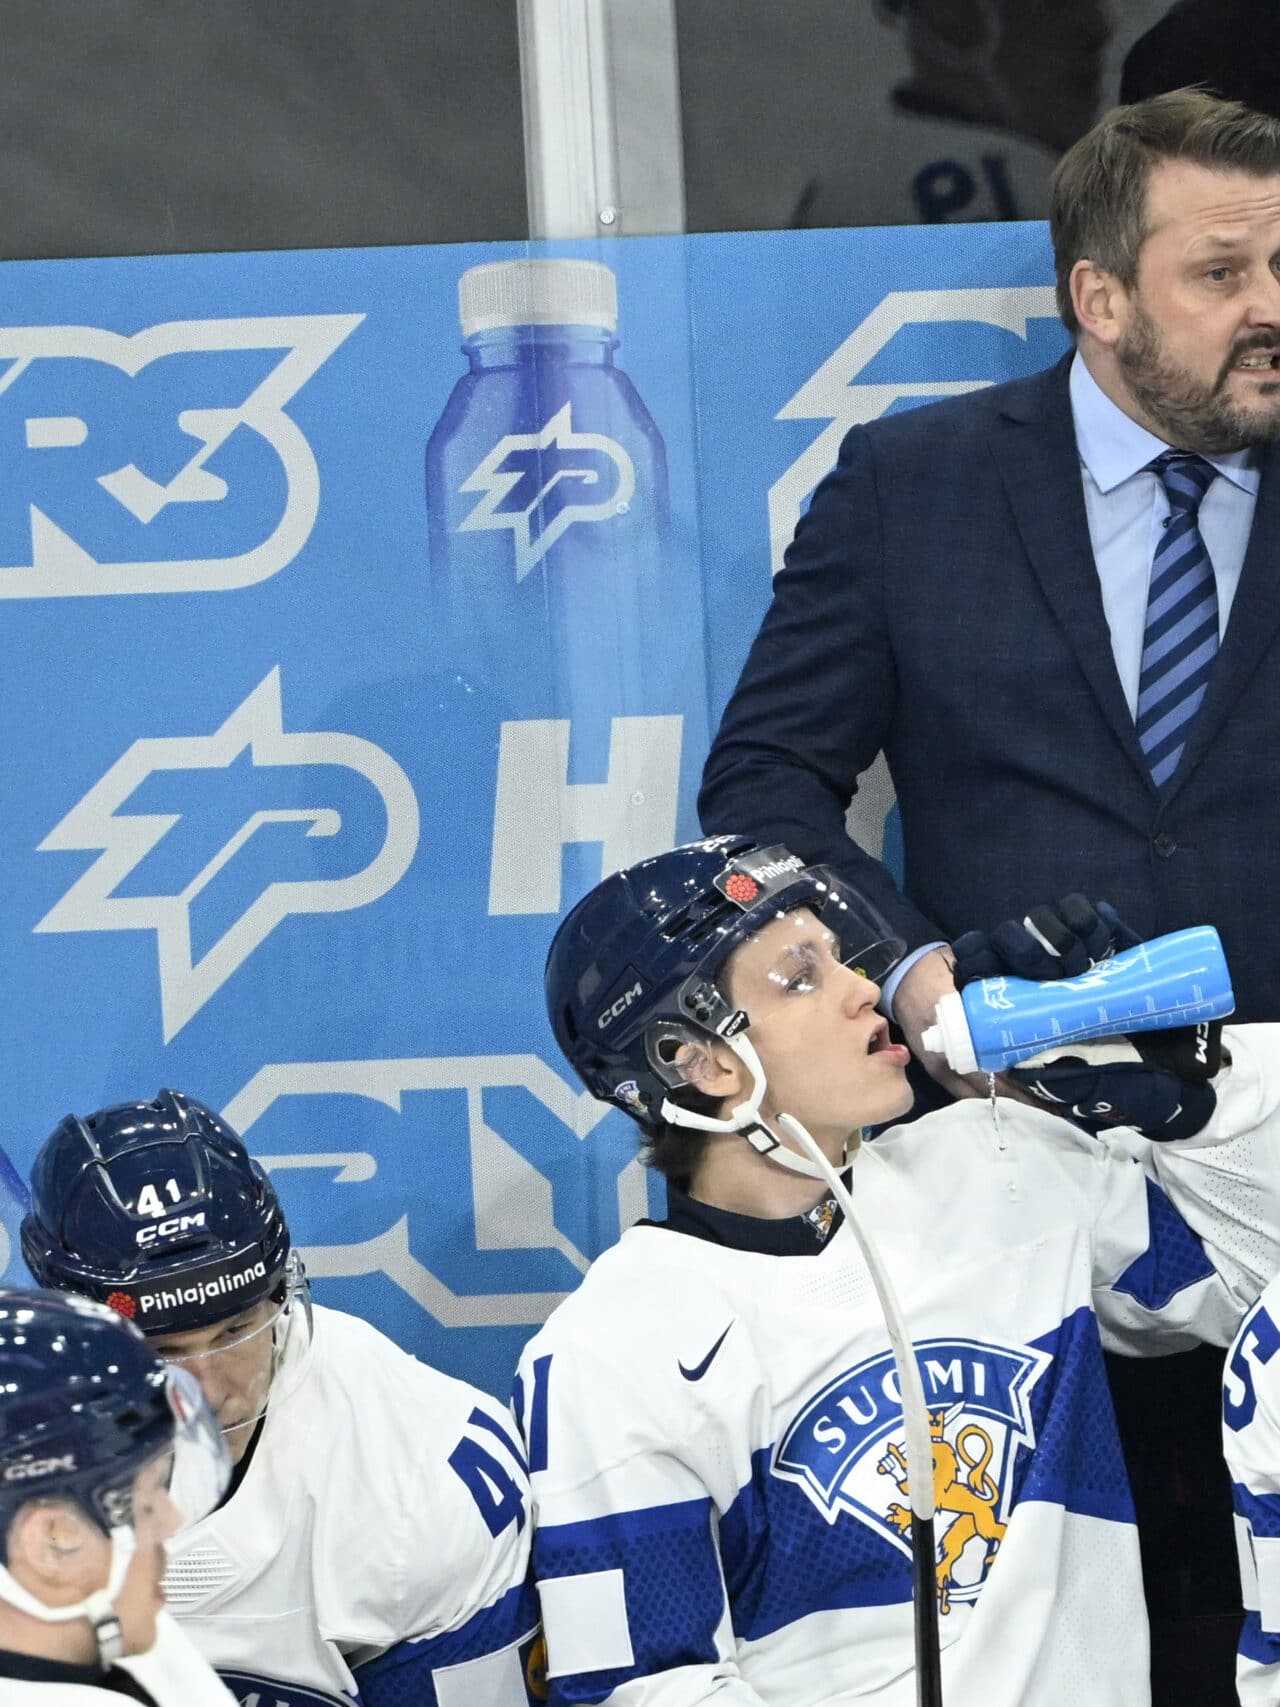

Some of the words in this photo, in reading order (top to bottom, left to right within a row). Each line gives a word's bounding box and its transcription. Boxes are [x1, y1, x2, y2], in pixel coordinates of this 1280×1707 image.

[598, 982, 643, 1030] CCM
[1195, 1021, 1209, 1064] CM
[136, 1178, 182, 1218] 41
[136, 1212, 206, 1244] CCM
[140, 1261, 267, 1313] Pihlajalinna
[4, 1454, 78, 1481] CCM
